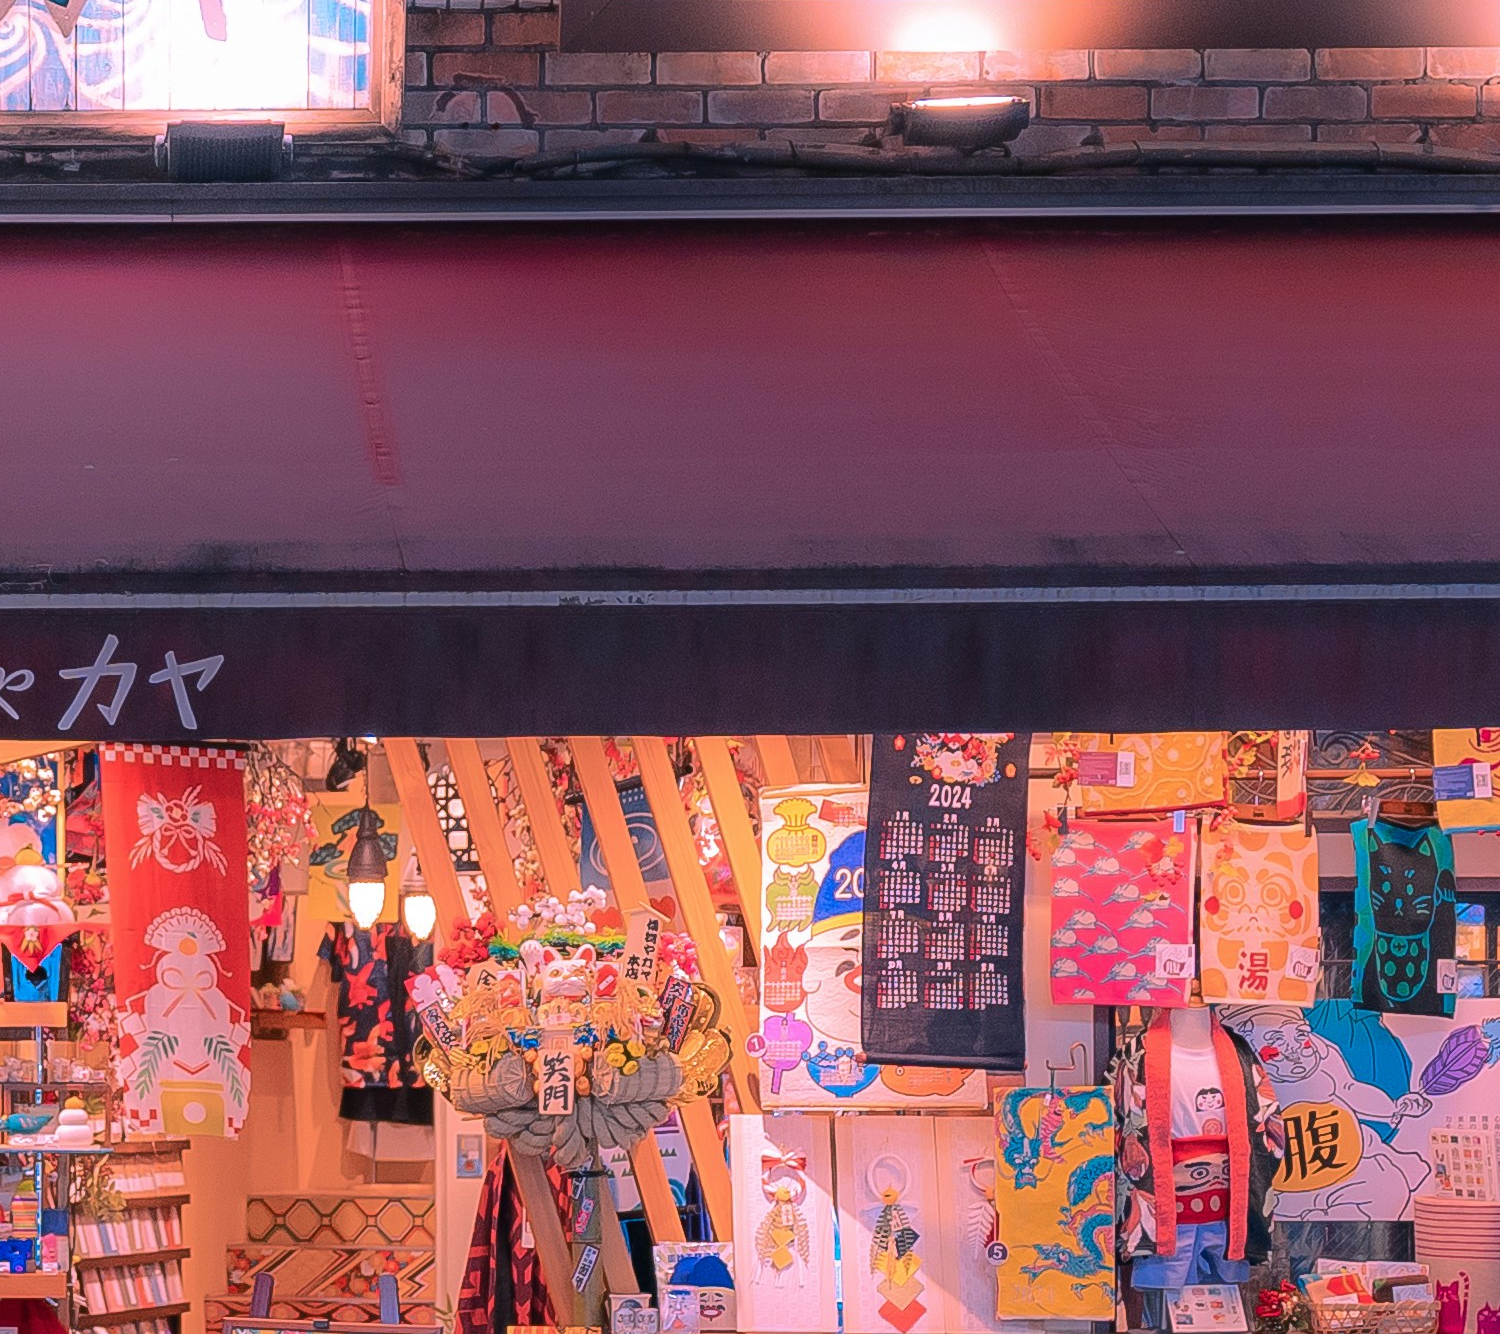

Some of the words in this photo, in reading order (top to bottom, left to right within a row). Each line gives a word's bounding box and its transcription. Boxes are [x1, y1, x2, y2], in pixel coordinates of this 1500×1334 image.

[57, 633, 225, 731] カヤ
[928, 783, 973, 810] 2024
[1238, 950, 1270, 992] 湯
[1282, 1110, 1349, 1184] 腹
